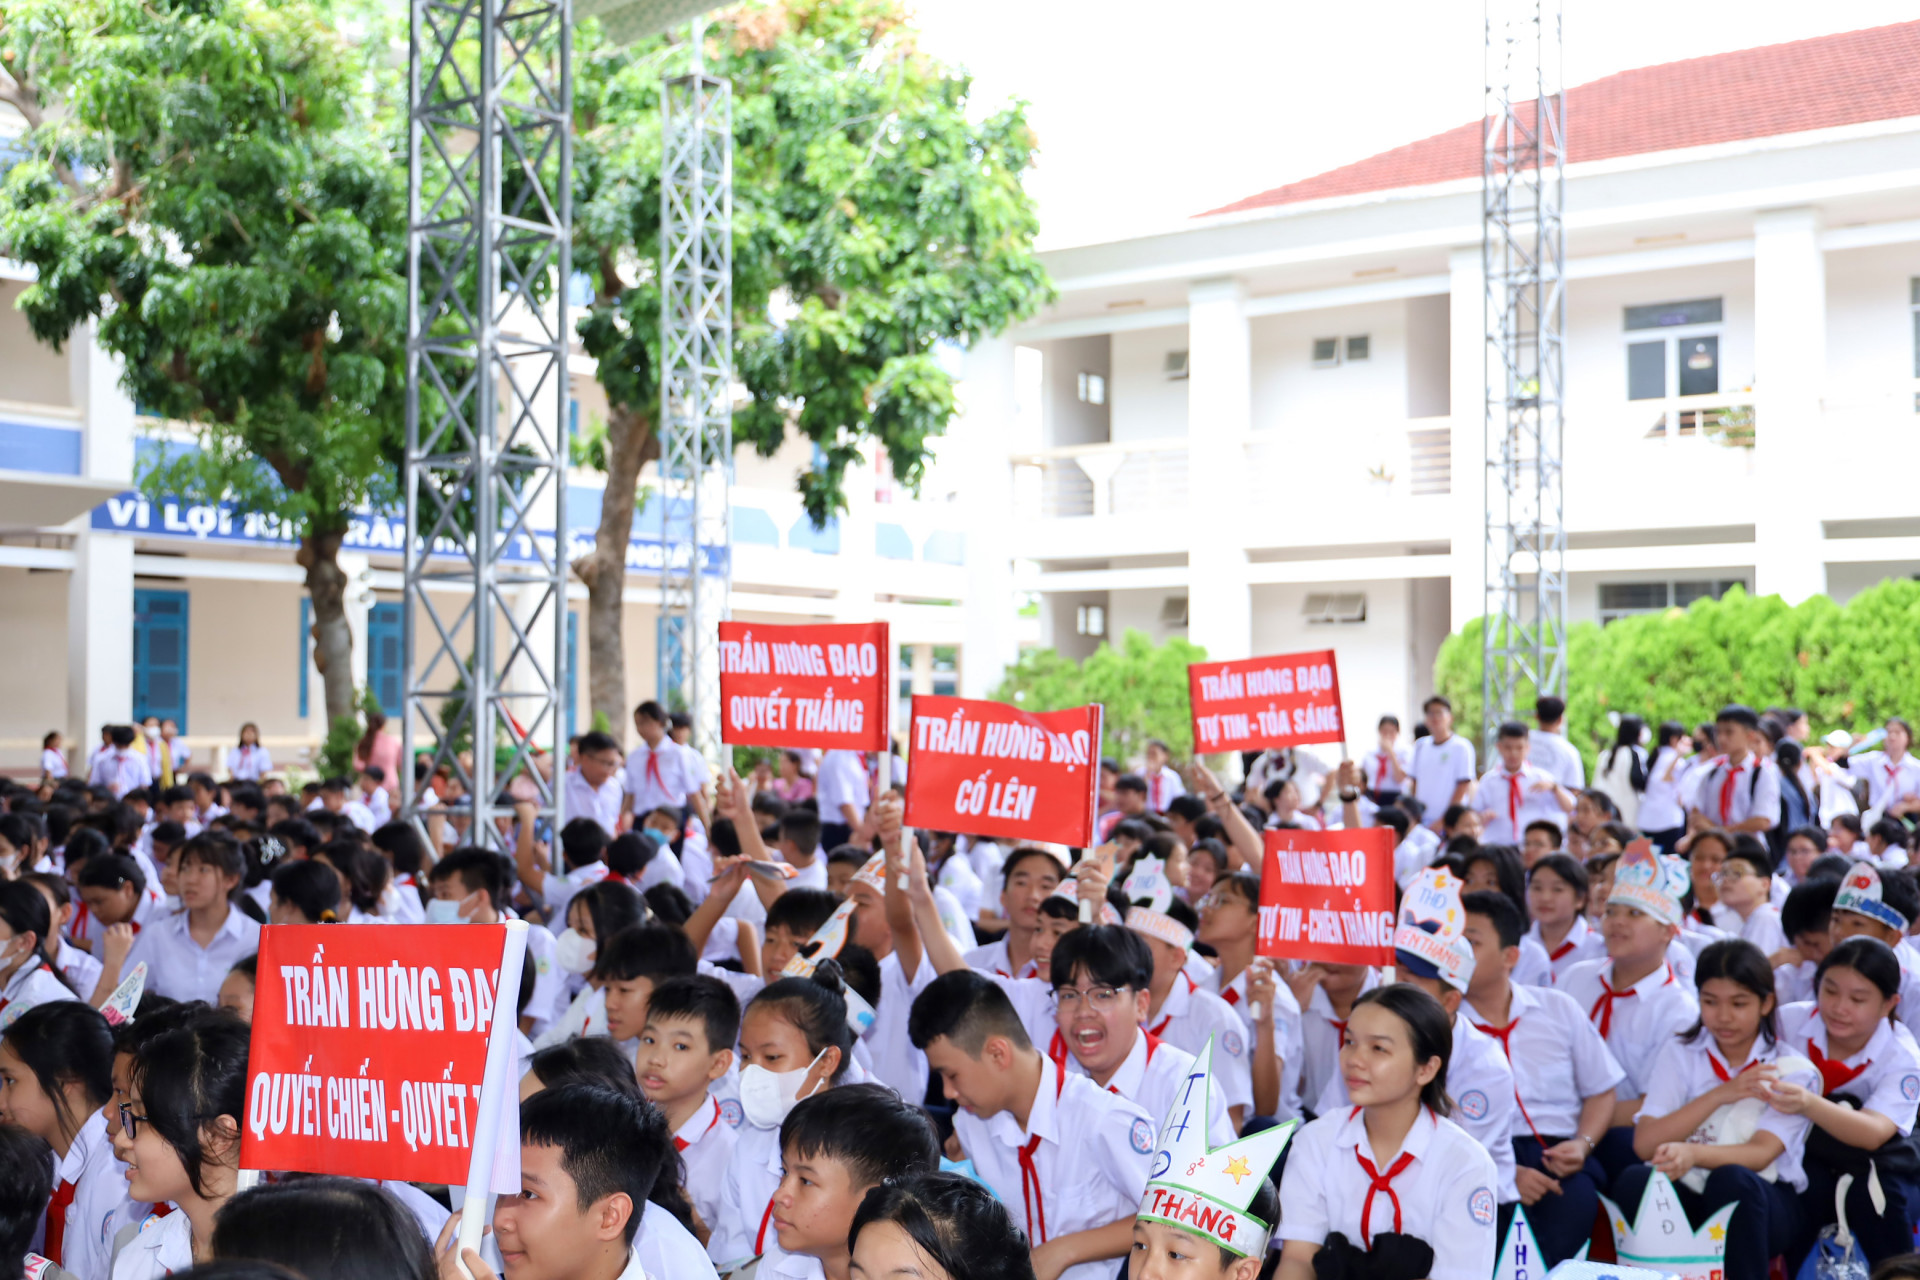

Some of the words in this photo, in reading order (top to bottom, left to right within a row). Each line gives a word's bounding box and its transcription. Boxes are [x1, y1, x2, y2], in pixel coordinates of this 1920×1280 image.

[719, 630, 770, 674] TRẦN
[771, 640, 828, 677] HƯNG
[828, 642, 878, 685] ĐẠO
[1245, 667, 1294, 697] HƯNG
[1295, 663, 1333, 697] ĐẠO
[730, 686, 792, 733] QUYẾT
[795, 686, 864, 734] THẮNG
[915, 706, 981, 756] TRẦN
[981, 719, 1046, 762] HƯNG
[1197, 713, 1221, 747] TỰ
[1221, 713, 1250, 741] TIN
[1292, 702, 1340, 735] SÁNG
[954, 768, 992, 816] CỐ
[987, 775, 1038, 821] LÊN
[1328, 849, 1366, 895] ĐẠO
[1258, 903, 1281, 947] TỰ
[1279, 906, 1303, 942] TIN
[1340, 898, 1395, 948] THẮNG
[280, 944, 350, 1028] TRẦN
[357, 960, 445, 1031] HƯNG
[449, 967, 500, 1048] ĐẠ
[250, 1054, 322, 1141] QUYẾT
[327, 1057, 388, 1143] CHIẾN
[401, 1061, 470, 1152] QUYẾT
